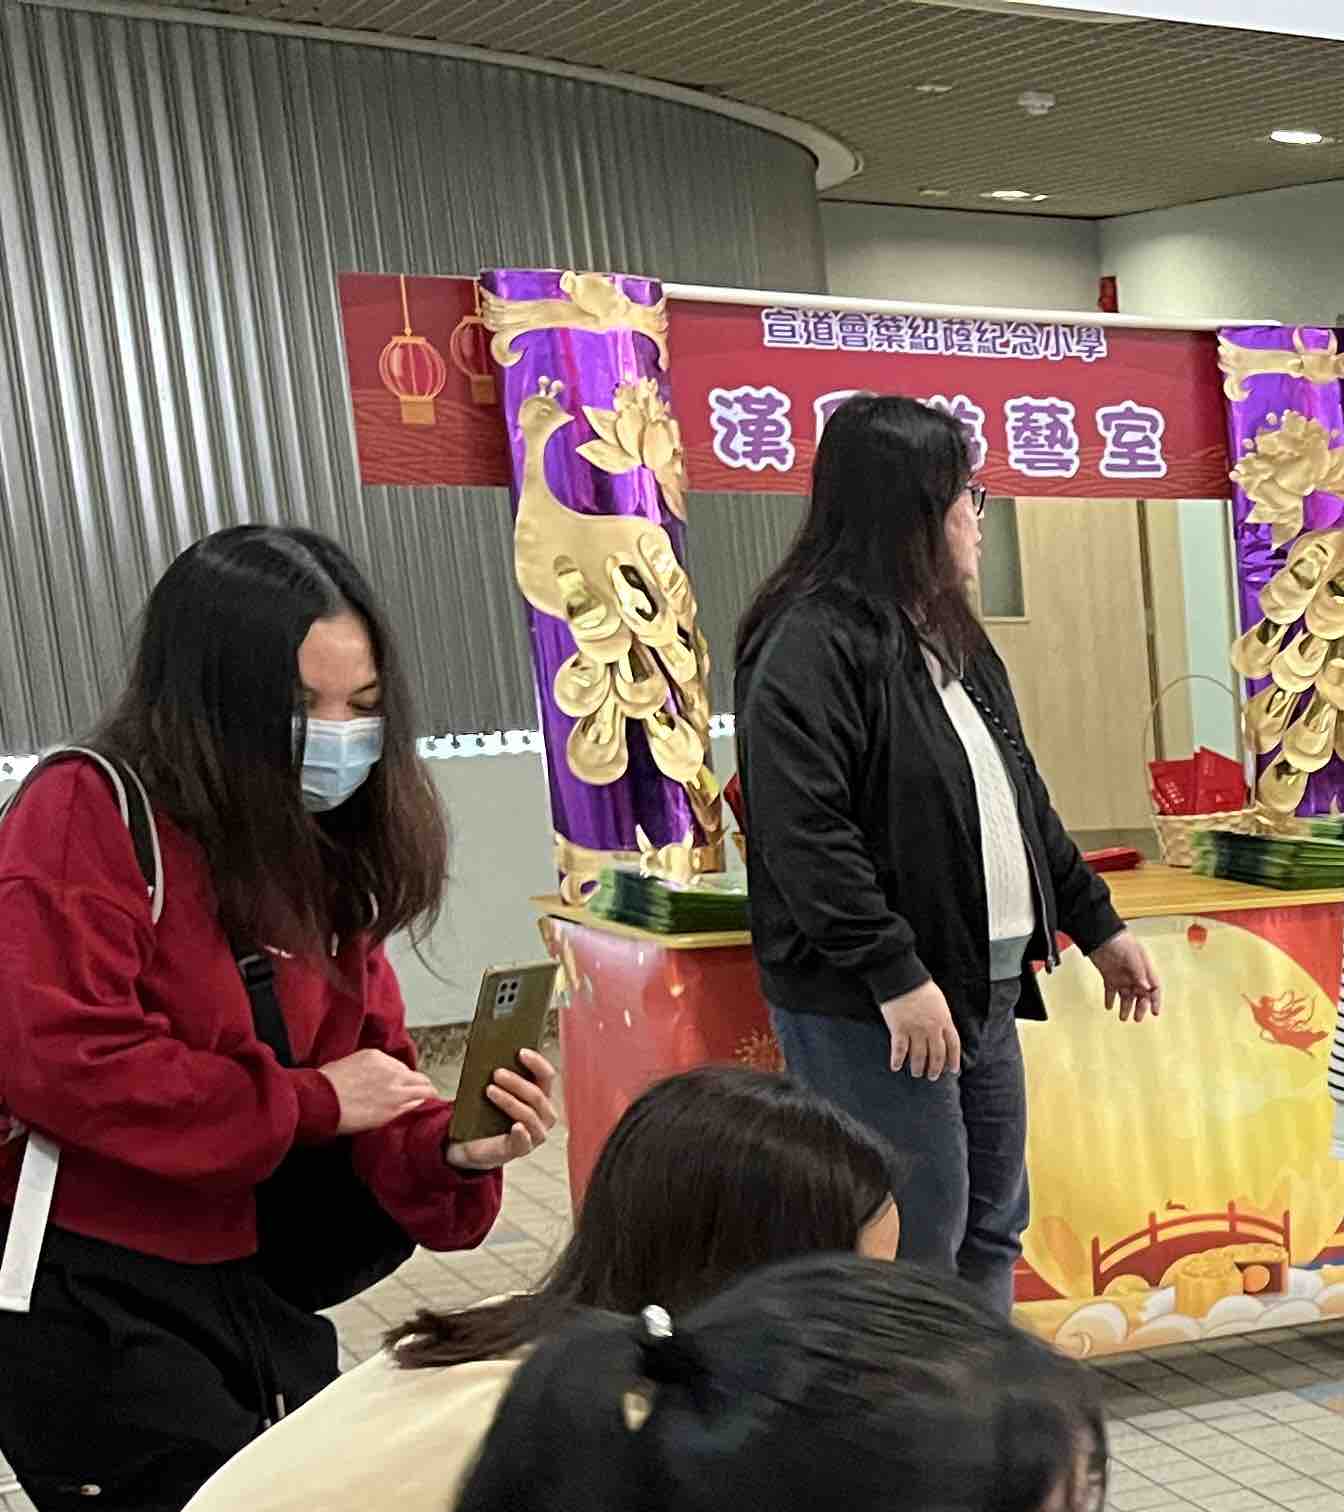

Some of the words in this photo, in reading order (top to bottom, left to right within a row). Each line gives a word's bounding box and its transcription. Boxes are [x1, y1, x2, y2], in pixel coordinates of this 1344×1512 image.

[762, 307, 1107, 361] 宣道會葉紹蔭紀念小學
[709, 385, 1166, 478] 漢藝室
